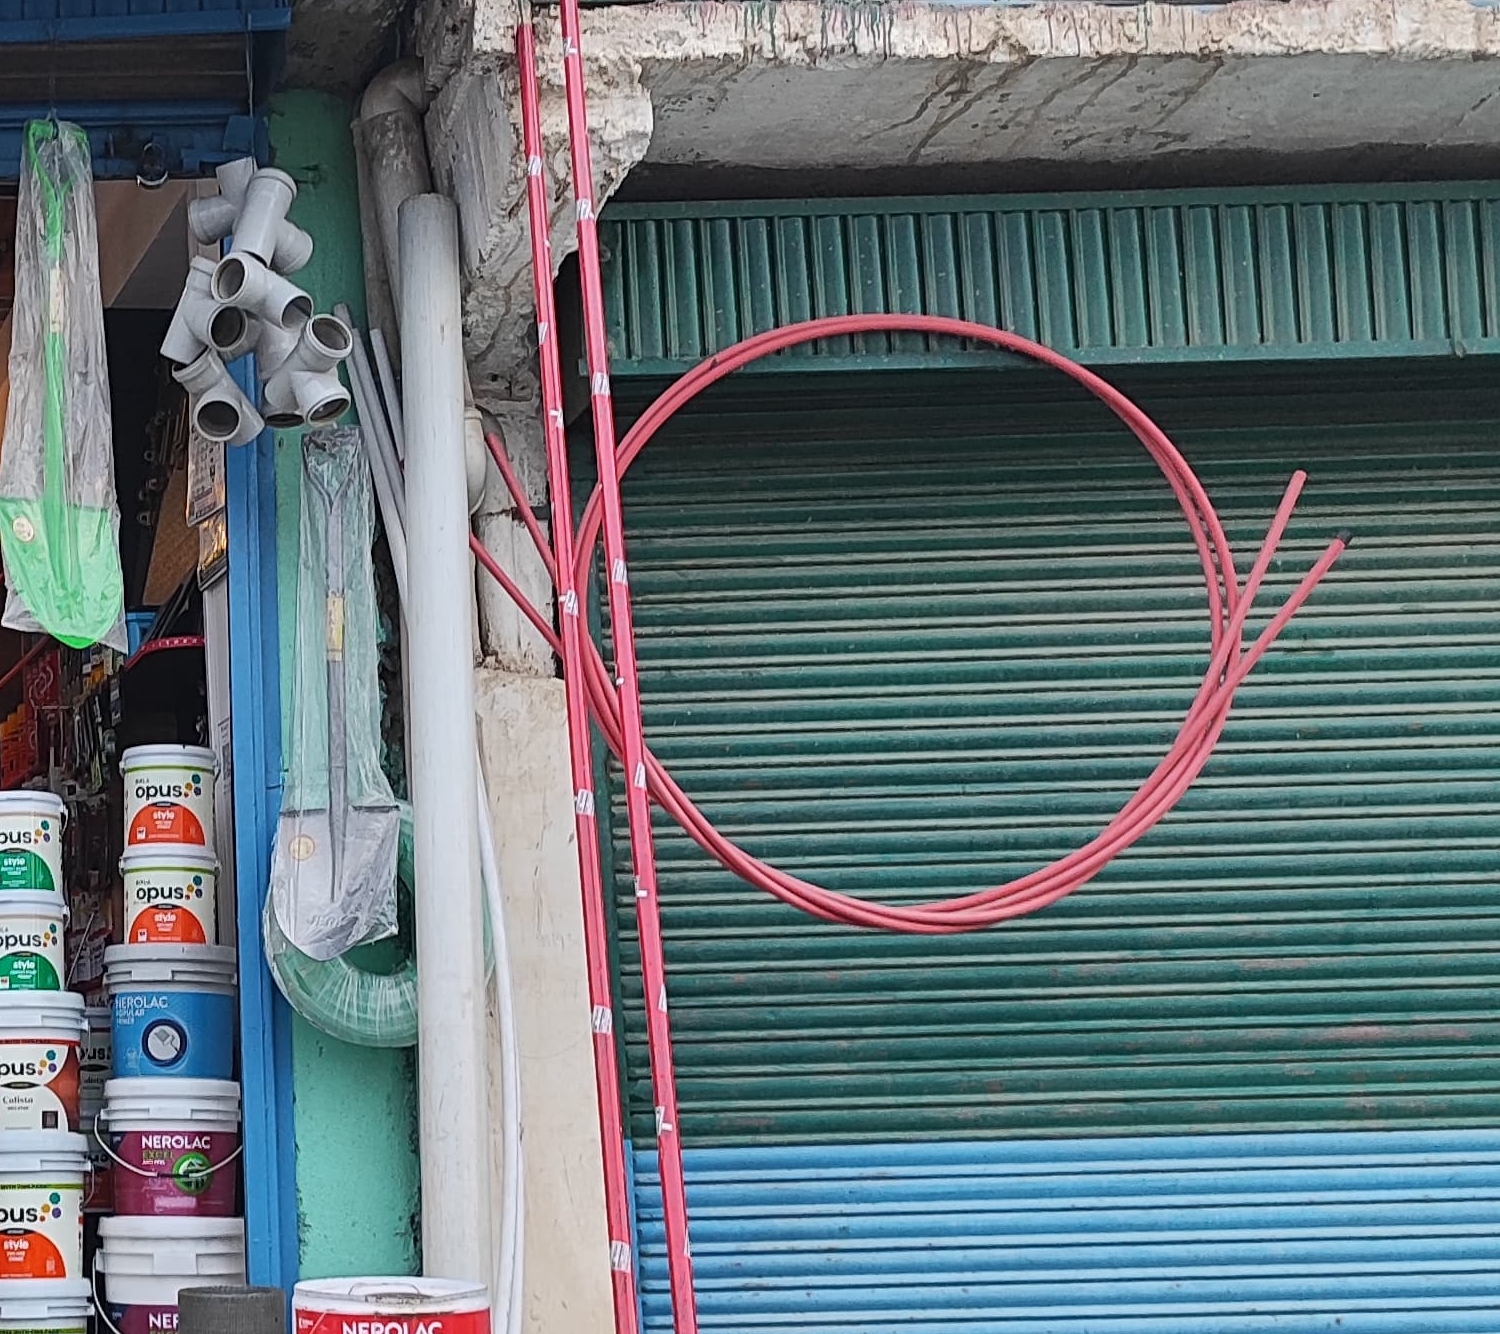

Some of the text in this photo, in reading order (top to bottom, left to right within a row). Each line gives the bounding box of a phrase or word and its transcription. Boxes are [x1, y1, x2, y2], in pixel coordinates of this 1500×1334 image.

[135, 784, 182, 801] opus
[136, 886, 184, 903] opus
[116, 995, 168, 1009] NEROLAC
[141, 1135, 211, 1149] NEROLAC
